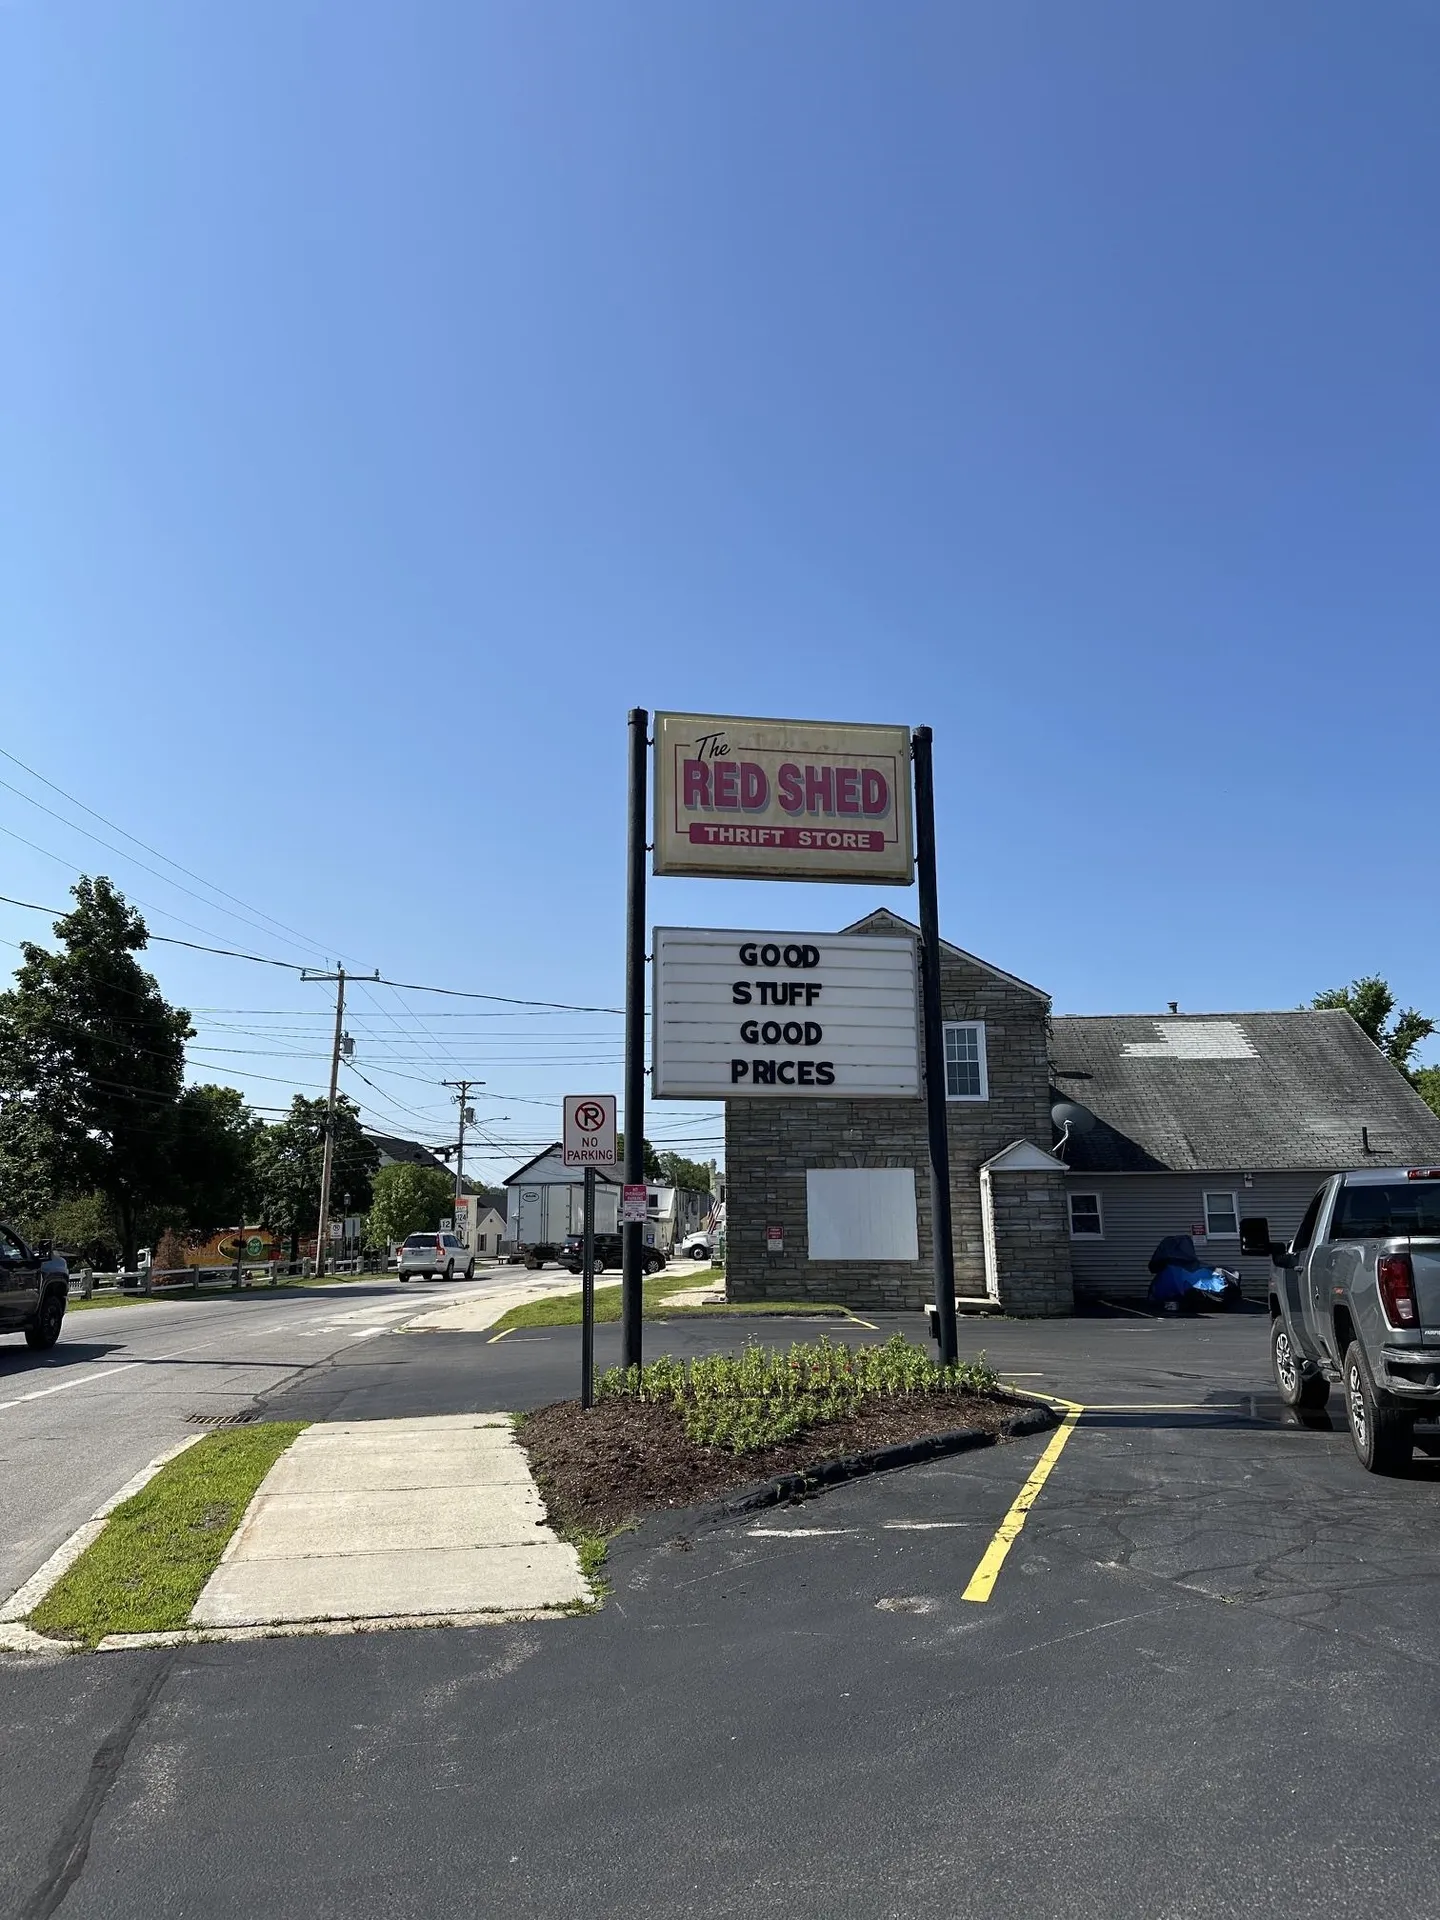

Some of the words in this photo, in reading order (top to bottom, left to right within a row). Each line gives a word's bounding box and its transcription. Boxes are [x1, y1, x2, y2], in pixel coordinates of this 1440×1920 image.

[695, 732, 731, 762] The
[683, 759, 769, 813] RED
[778, 763, 890, 819] SHED
[704, 827, 785, 845] THRIFT
[798, 831, 871, 849] STORE
[739, 942, 820, 968] GOOD
[732, 981, 822, 1007] STUFF
[740, 1020, 823, 1046] GOOD
[731, 1059, 835, 1086] PRICES
[567, 1150, 613, 1161] PARKING
[582, 1137, 598, 1148] NO
[442, 1220, 451, 1228] 12
